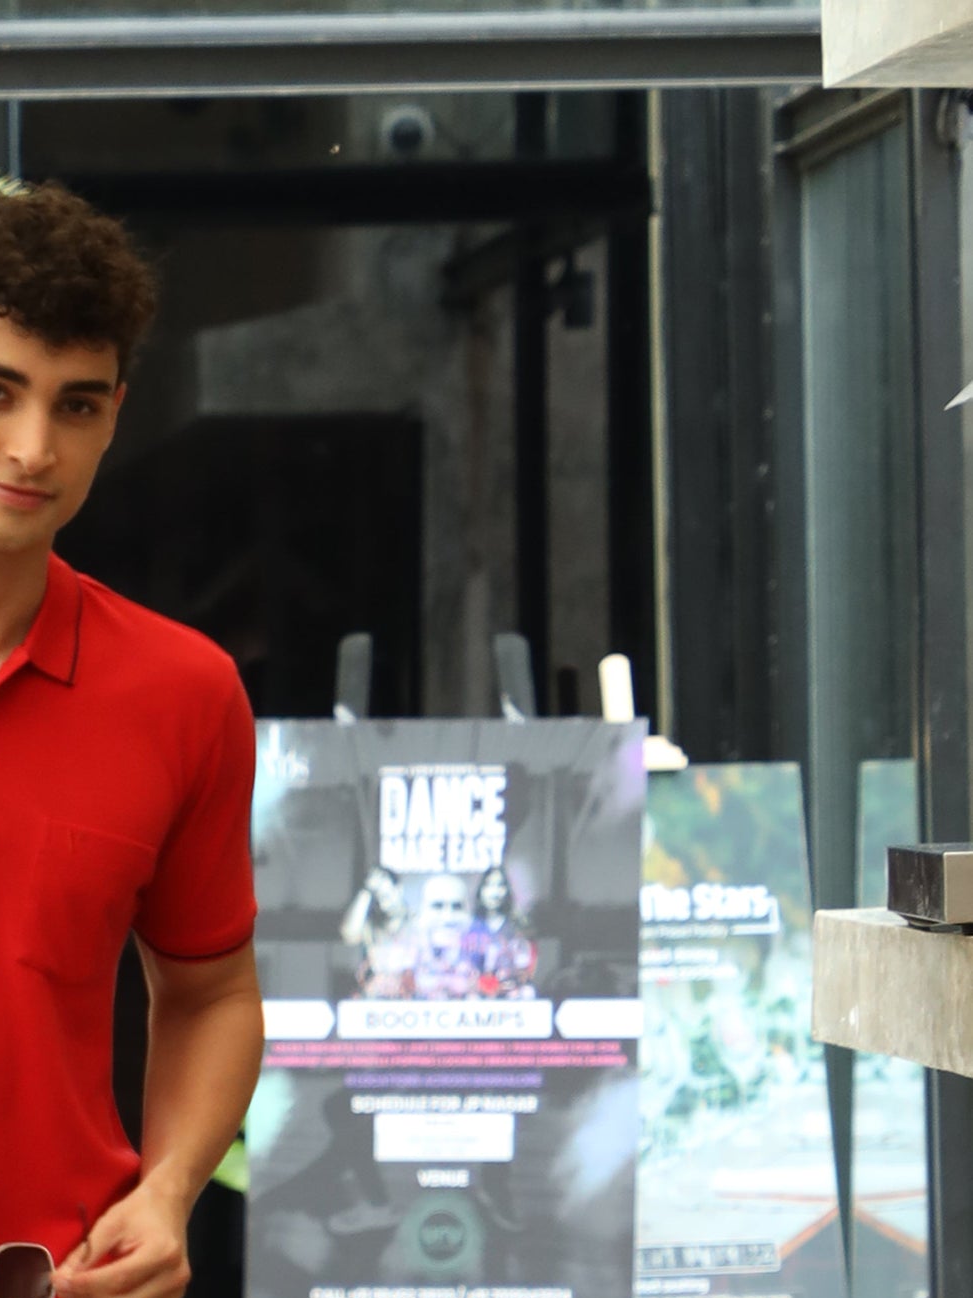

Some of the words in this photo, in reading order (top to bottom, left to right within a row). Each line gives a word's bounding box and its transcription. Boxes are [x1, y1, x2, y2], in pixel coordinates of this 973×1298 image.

[380, 775, 506, 836] DANCE
[447, 836, 506, 872] EASY
[640, 883, 690, 921] The
[692, 882, 768, 920] Stars
[365, 1010, 525, 1029] BOOTCAMPS
[416, 1168, 469, 1188] VENUE
